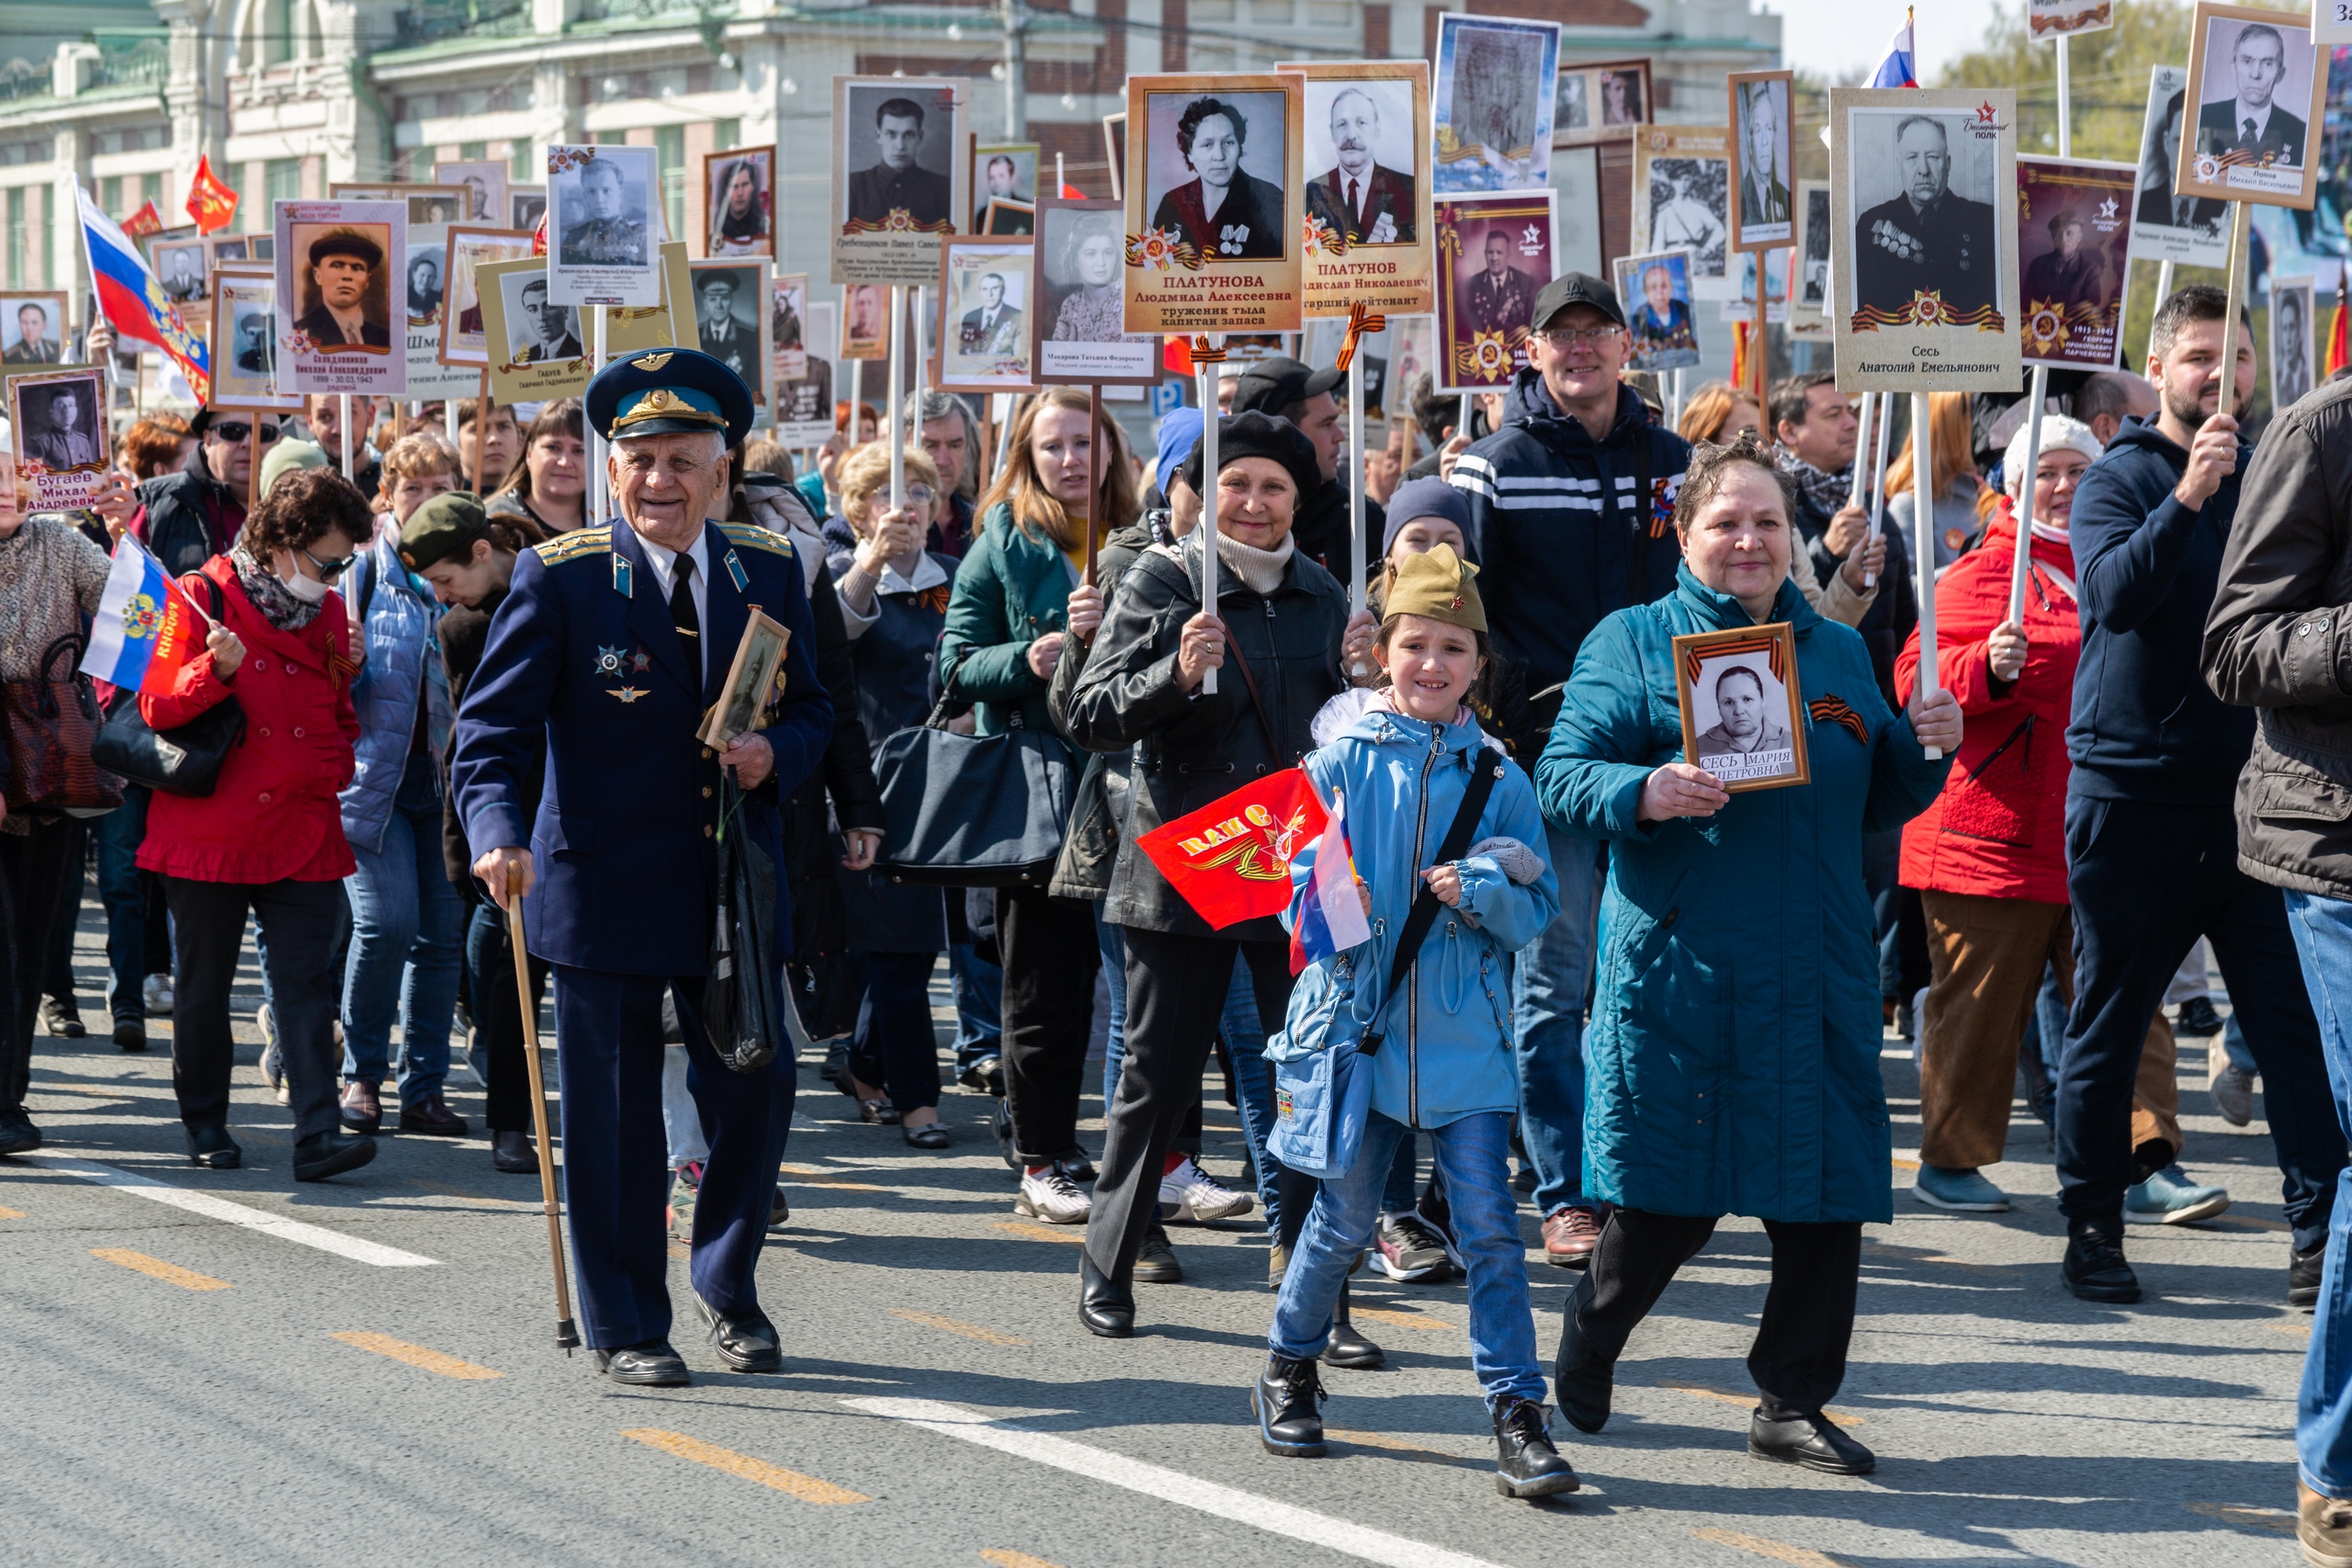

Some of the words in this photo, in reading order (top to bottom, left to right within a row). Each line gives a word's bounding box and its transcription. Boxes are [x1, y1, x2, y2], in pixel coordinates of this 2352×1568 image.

[1975, 131, 1996, 140] ПОЛК
[2254, 170, 2277, 179] Попов
[2229, 175, 2256, 185] Михаил
[2258, 179, 2300, 190] Васильевич
[891, 240, 914, 248] Павел
[1317, 263, 1396, 276] ПЛАТУНОВ
[1163, 276, 1264, 288] ПЛАТУНОВА
[1355, 278, 1428, 289] Николаевич
[1135, 292, 1204, 303] Людмила
[1208, 291, 1292, 302] Алексеевна
[1161, 307, 1228, 318] труженик
[1232, 307, 1265, 315] тыла
[1161, 318, 1217, 326] капитан
[1221, 317, 1265, 325] запаса
[1912, 345, 1939, 356] Сесь
[1858, 362, 1915, 373] Анатолий
[1921, 362, 2000, 373] Емельянович
[537, 369, 561, 378] ГАБУЕВ
[312, 376, 329, 384] 1899
[335, 376, 373, 384] 30.03.1943
[37, 473, 92, 489] Бугаев
[42, 488, 87, 499] Михал
[1701, 755, 1737, 770] СЕСЬ
[1747, 751, 1791, 765] МАРИЯ
[1717, 764, 1781, 781] ПЕТРОВНА
